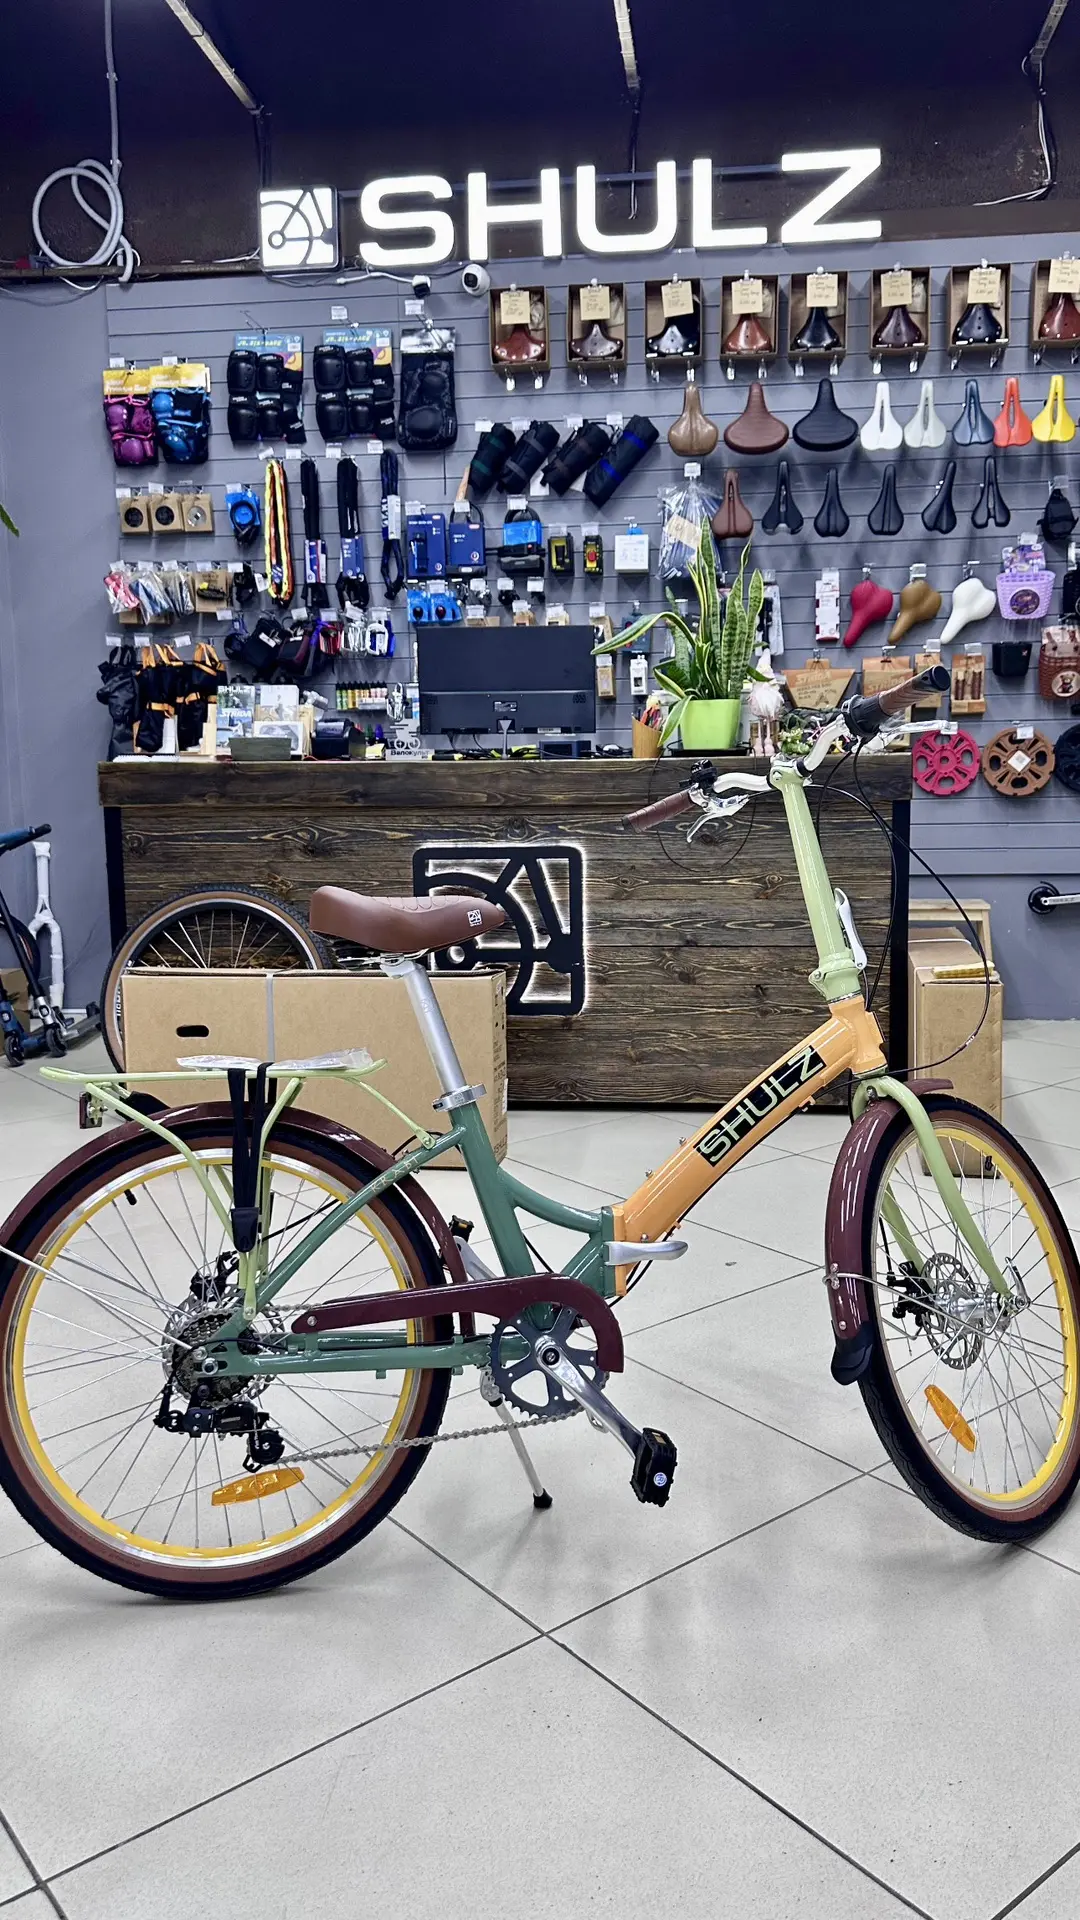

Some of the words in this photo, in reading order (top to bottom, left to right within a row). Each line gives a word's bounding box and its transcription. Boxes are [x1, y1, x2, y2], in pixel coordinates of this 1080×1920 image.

[359, 148, 882, 266] SHULZ
[217, 685, 250, 693] SHULZ
[698, 1045, 824, 1162] SHULZ
